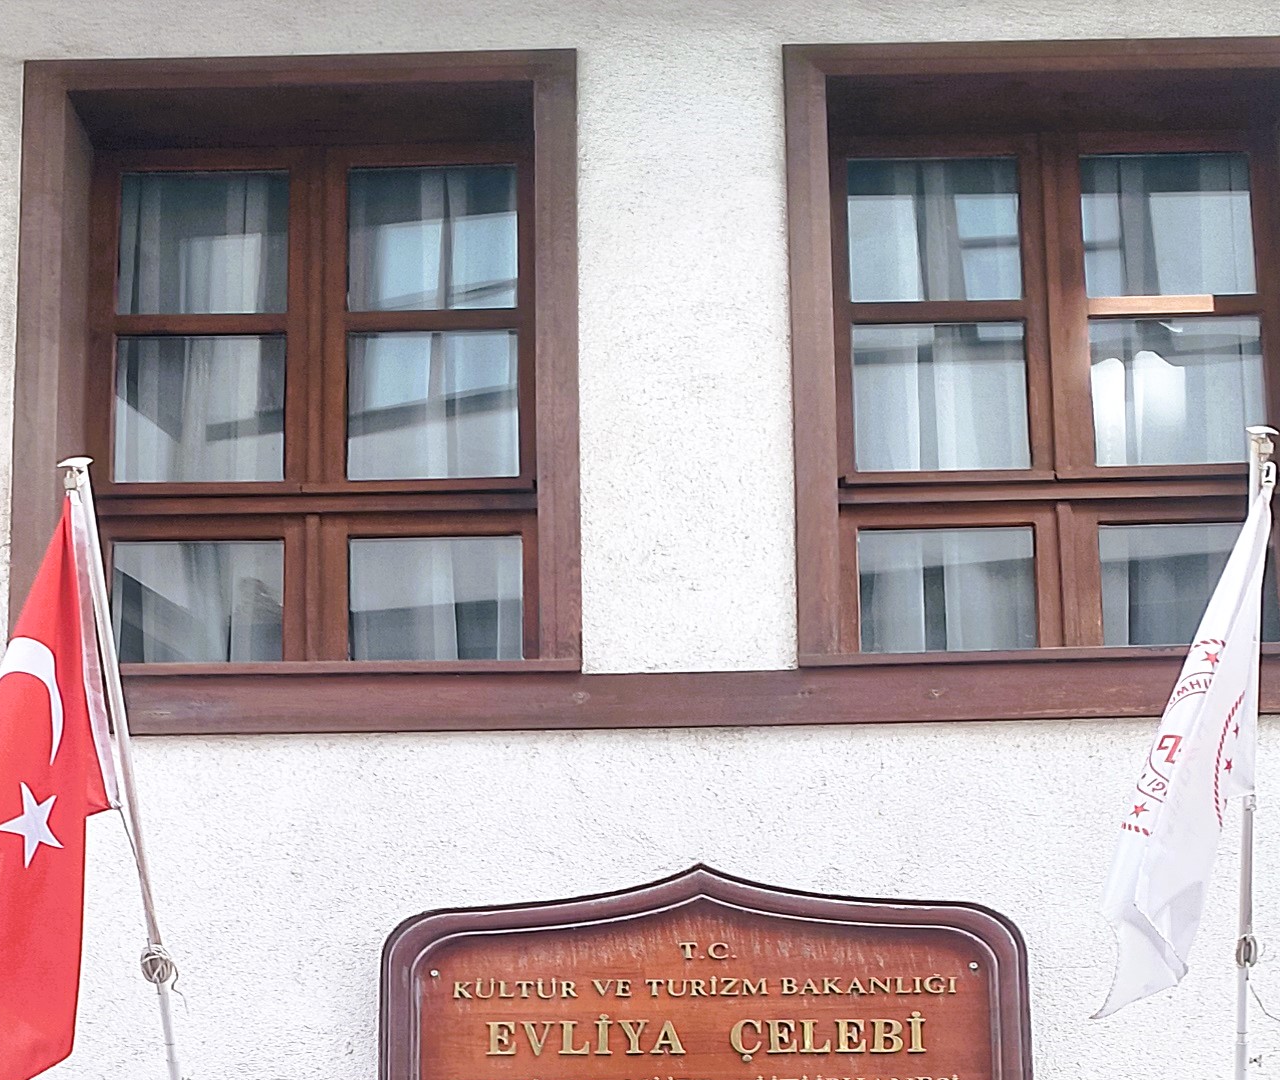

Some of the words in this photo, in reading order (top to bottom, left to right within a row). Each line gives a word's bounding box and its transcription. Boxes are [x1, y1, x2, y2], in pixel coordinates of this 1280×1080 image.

[679, 942, 738, 960] T.C.
[453, 977, 579, 999] KÜLTÜR
[591, 979, 633, 997] VE
[645, 975, 769, 997] TURİZM
[780, 973, 958, 996] BAKANLIĞI
[485, 1013, 687, 1056] EVLİYA
[729, 1011, 927, 1062] ÇELEBİ
